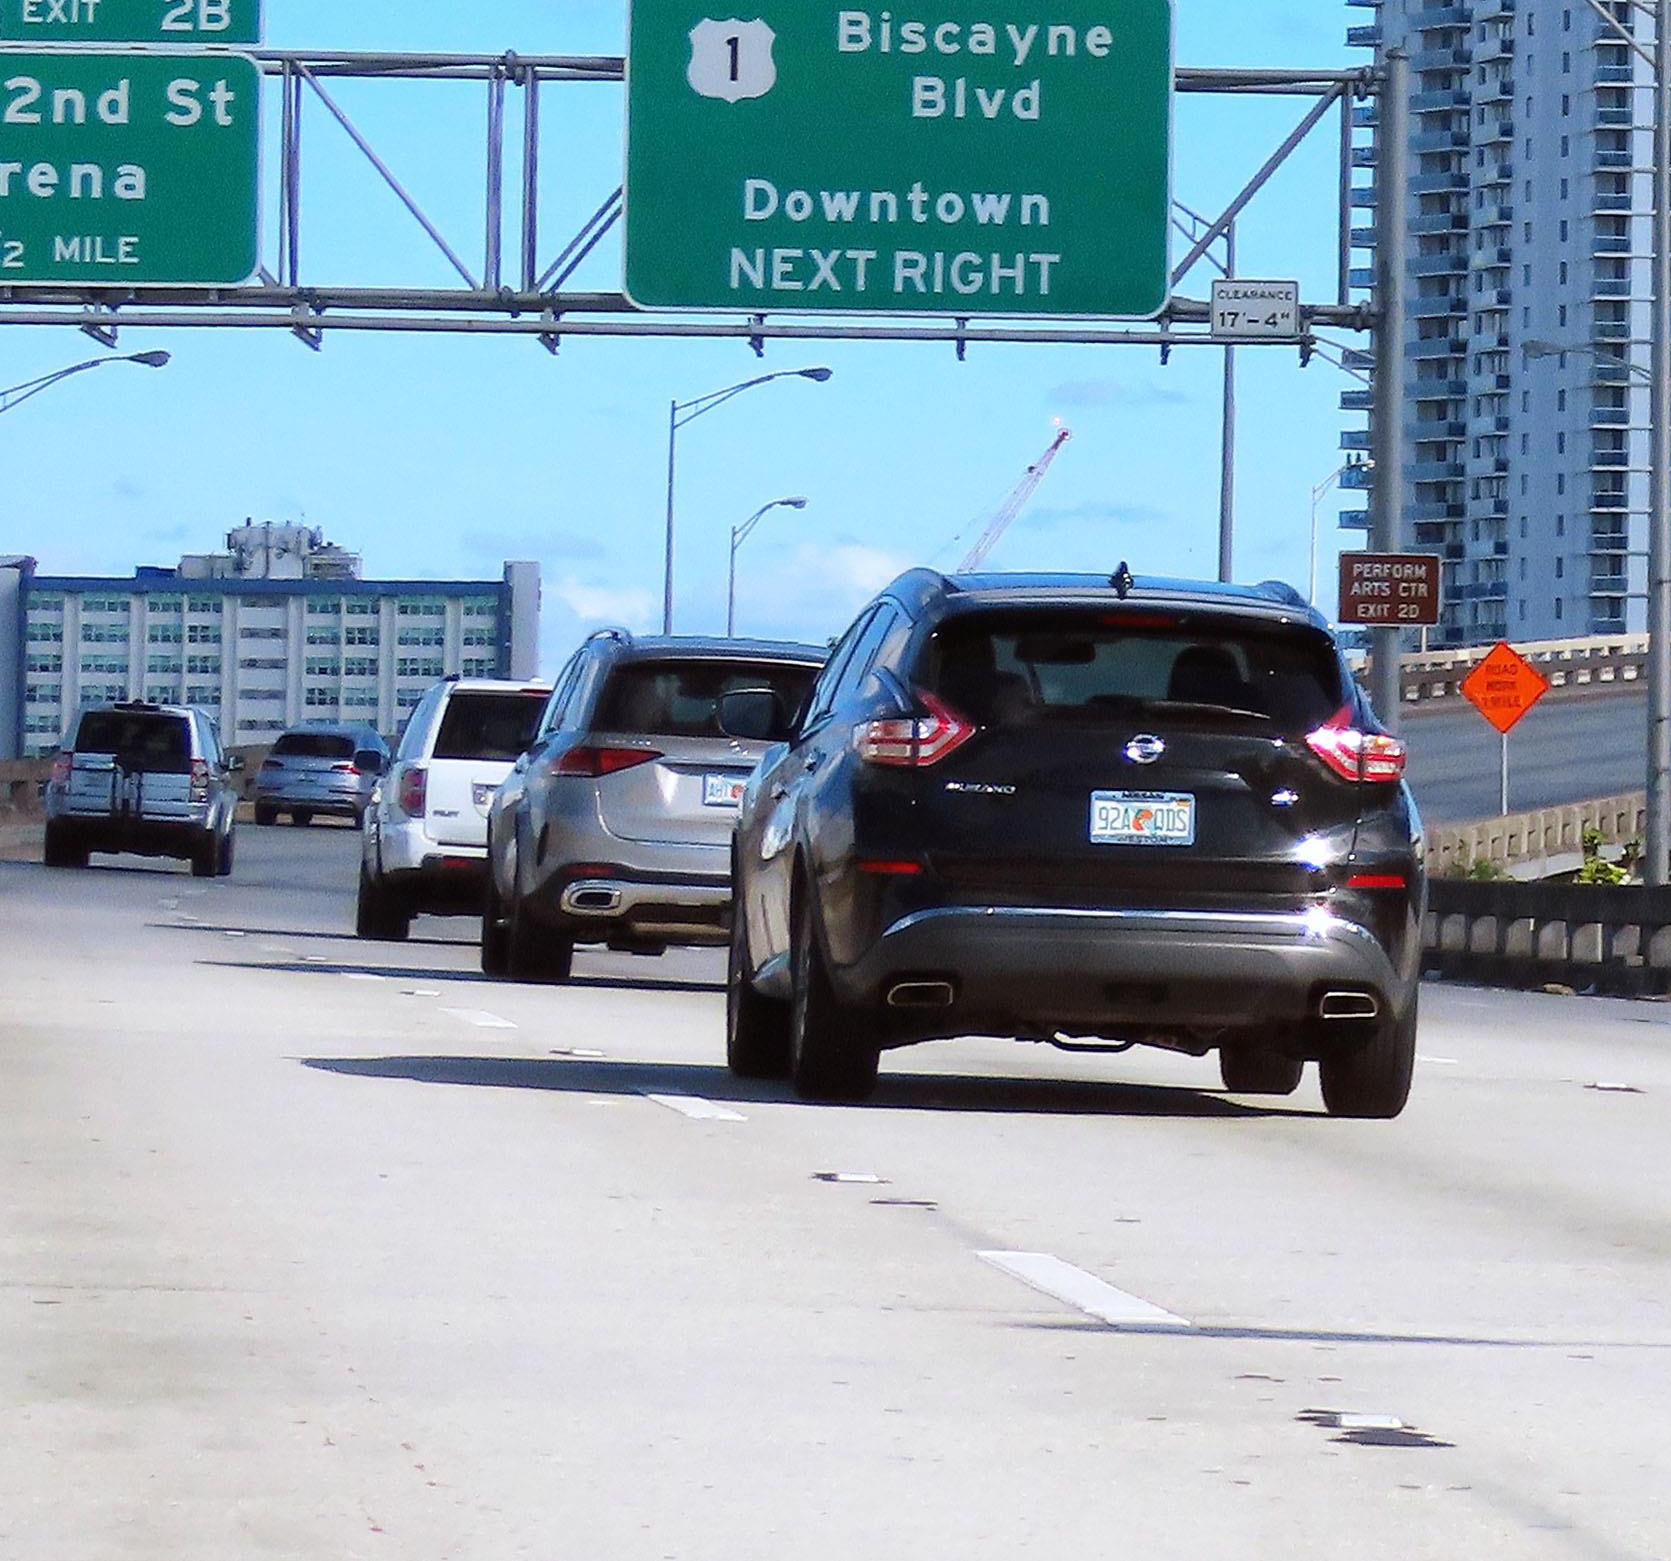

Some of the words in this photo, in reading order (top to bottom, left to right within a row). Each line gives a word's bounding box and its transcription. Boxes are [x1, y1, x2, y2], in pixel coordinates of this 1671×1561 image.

[726, 36, 739, 82] 1
[838, 10, 1114, 66] Biscayne
[3, 75, 130, 125] 2nd
[164, 77, 236, 127] St
[912, 76, 1041, 120] Blvd
[744, 178, 1051, 226] Downtown
[54, 235, 140, 264] MILE
[730, 247, 877, 292] NEXT
[893, 249, 1061, 296] RIGHT
[1217, 288, 1293, 301] CLEARANCE
[1350, 581, 1391, 597] ARTS
[1399, 582, 1429, 598] CTR
[1353, 563, 1427, 579] PERFORM
[1357, 603, 1391, 618] EXIT
[1398, 603, 1421, 619] 2D
